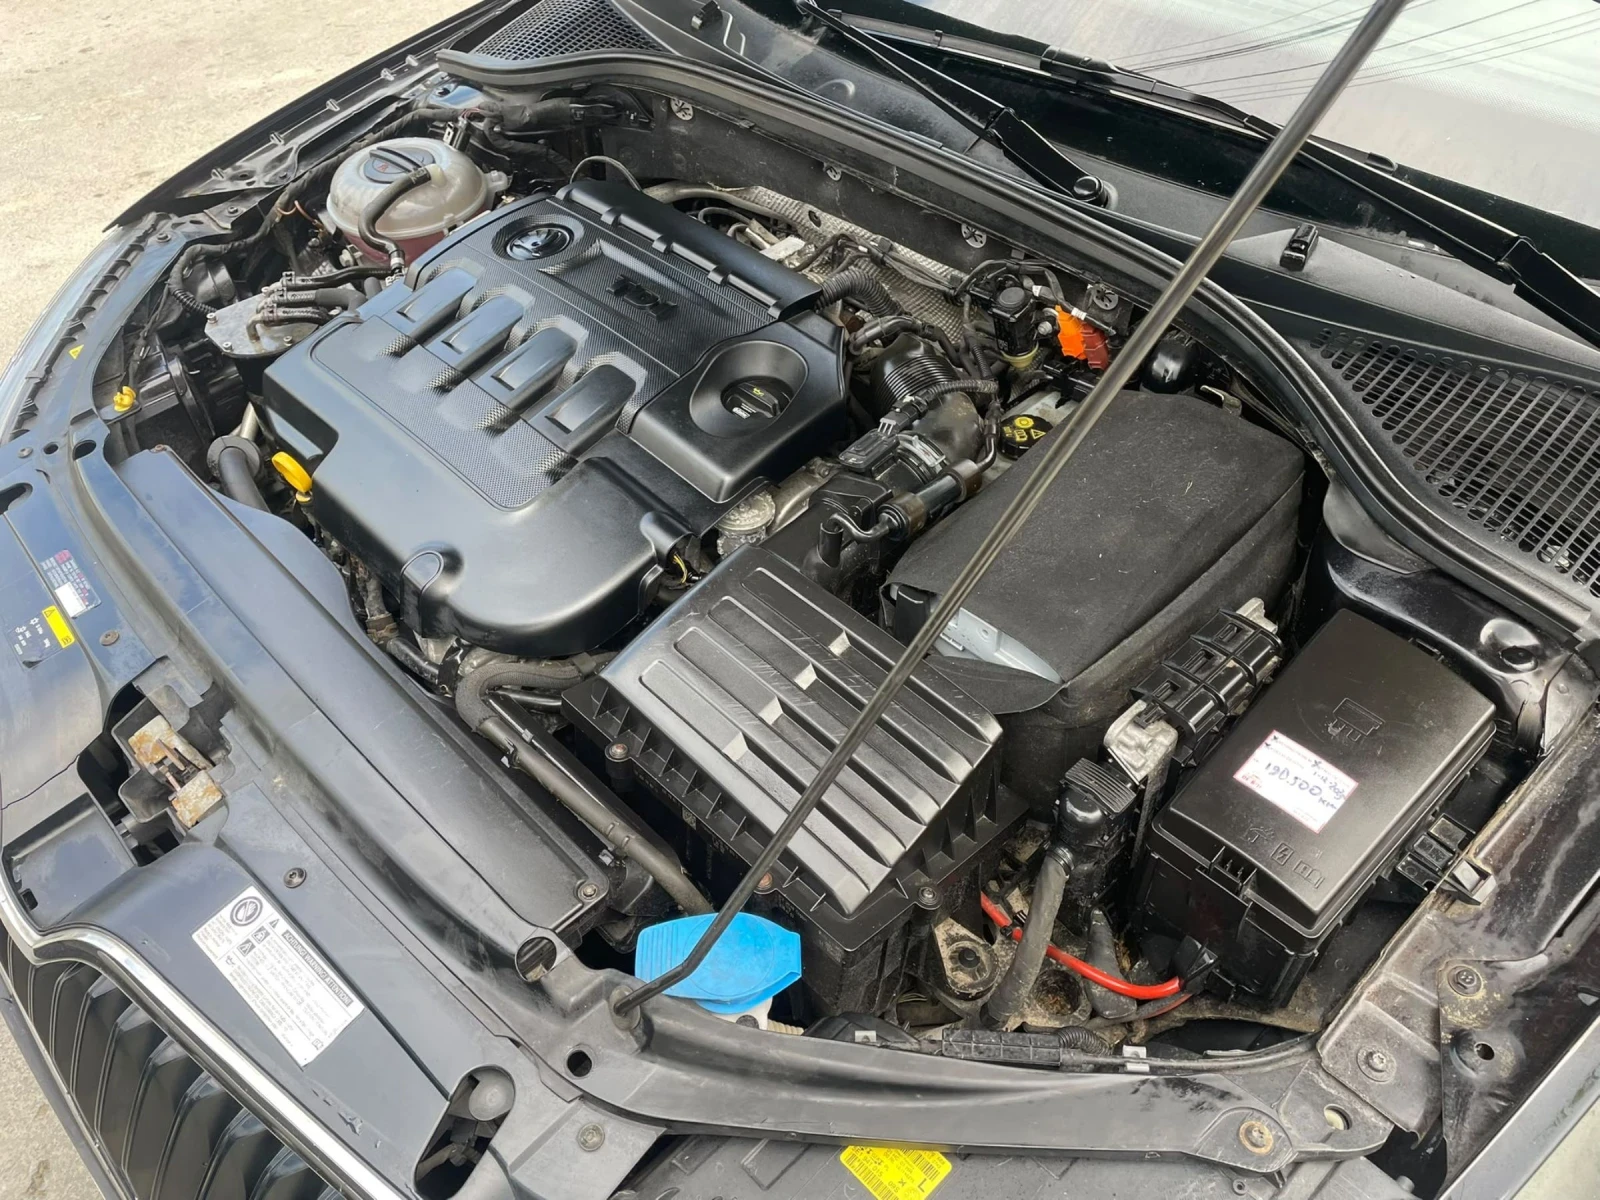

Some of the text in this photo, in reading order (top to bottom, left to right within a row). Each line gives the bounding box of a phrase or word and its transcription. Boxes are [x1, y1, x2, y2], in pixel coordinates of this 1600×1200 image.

[606, 274, 678, 321] TDI
[303, 954, 326, 979] WARNING!
[323, 976, 351, 1006] ATTENTION!
